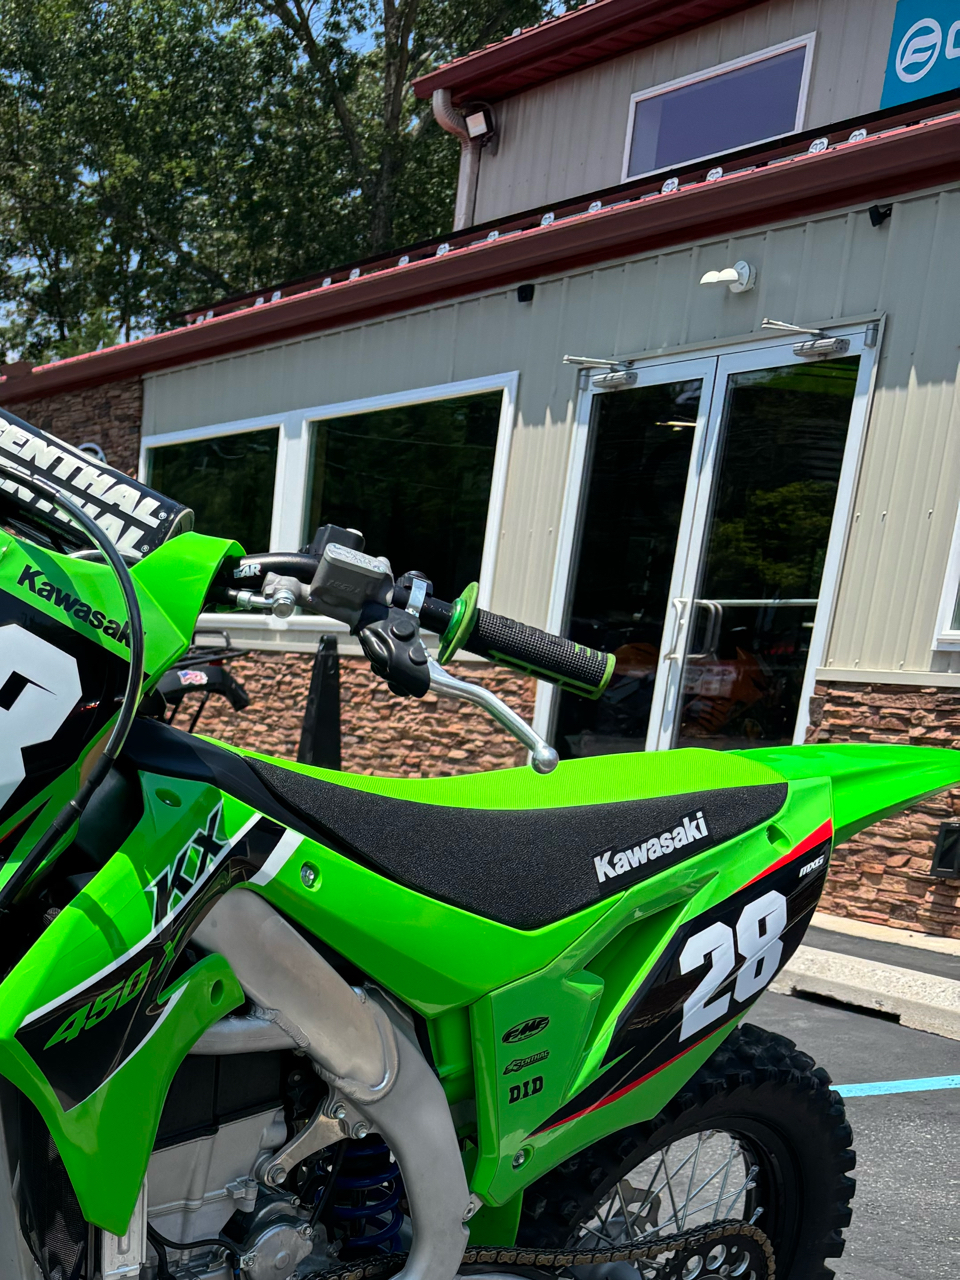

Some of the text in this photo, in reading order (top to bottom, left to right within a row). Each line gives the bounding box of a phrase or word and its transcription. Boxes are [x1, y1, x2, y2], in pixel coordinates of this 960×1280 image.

[17, 564, 146, 649] Kawasak
[594, 811, 709, 883] Kawasaki
[679, 890, 787, 1042] 28
